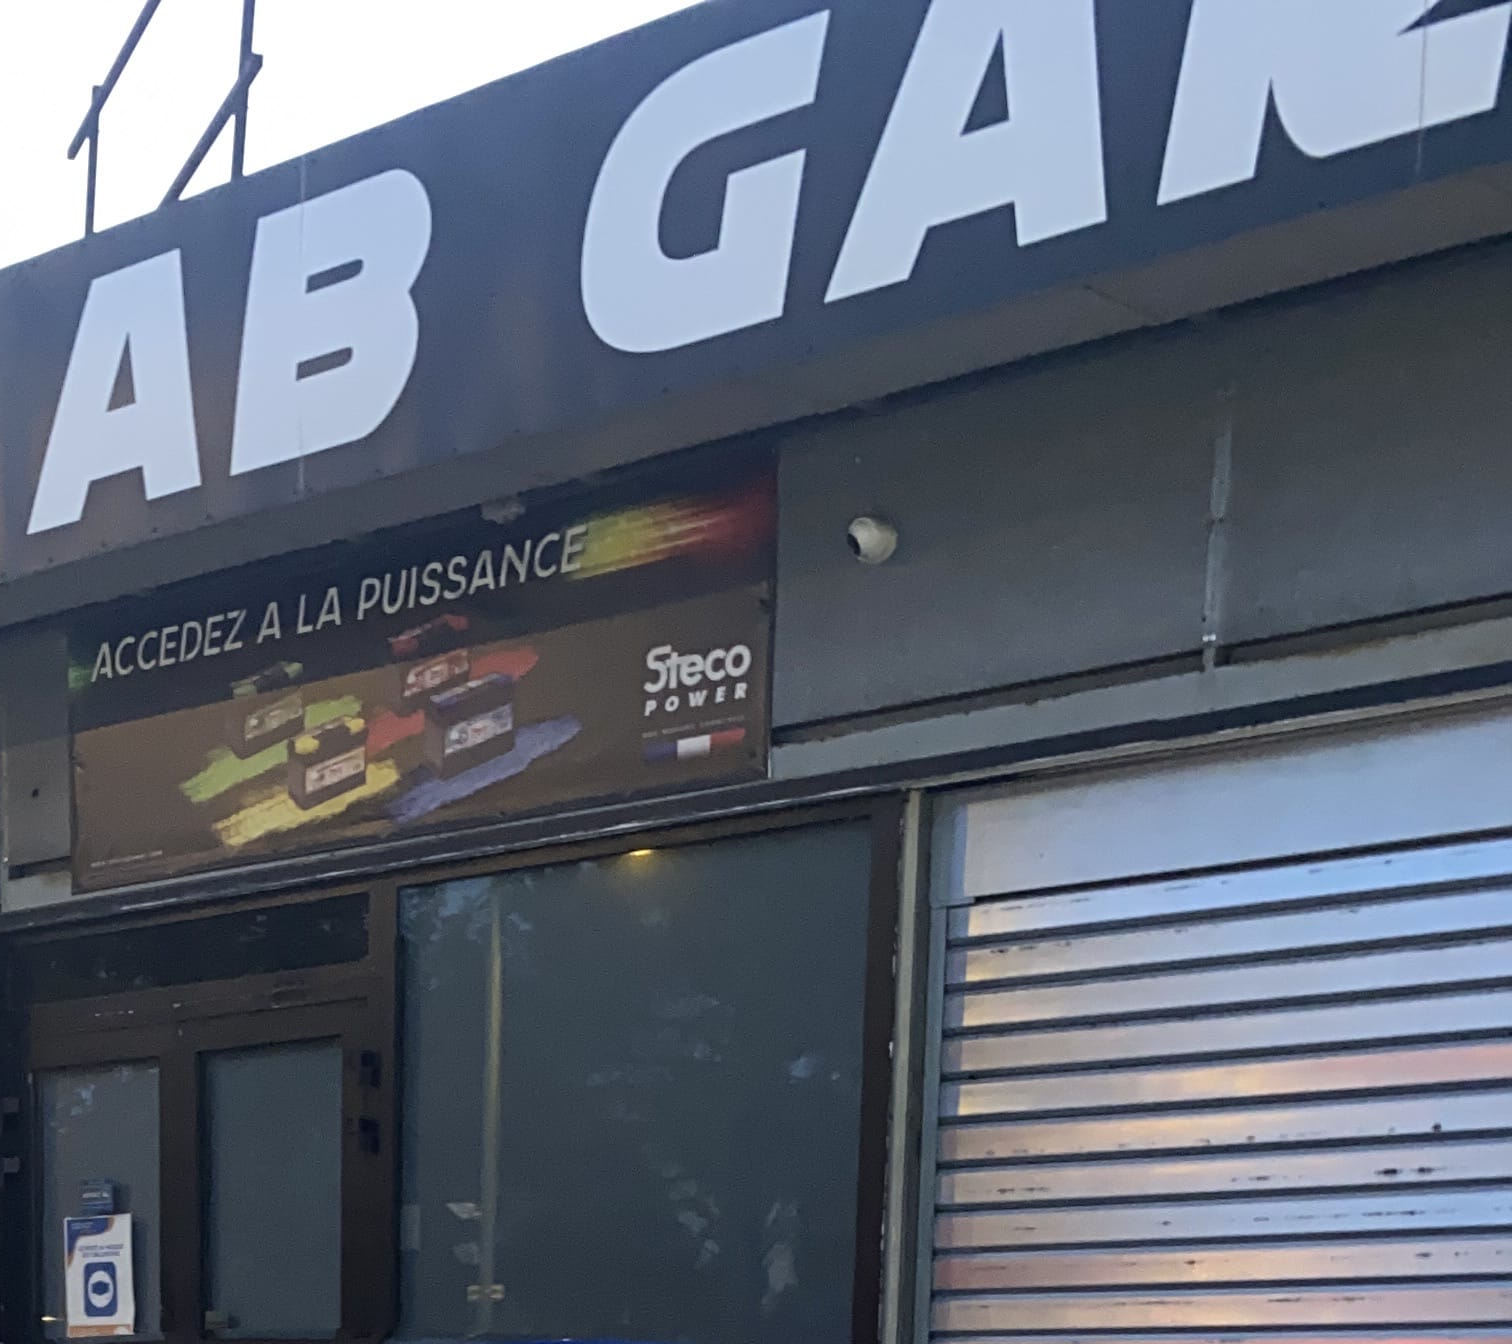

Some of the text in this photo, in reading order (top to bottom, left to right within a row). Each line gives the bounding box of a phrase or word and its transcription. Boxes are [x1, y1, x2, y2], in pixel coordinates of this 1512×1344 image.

[24, 168, 433, 534] AB
[91, 523, 588, 684] ACCEDEZ A LA PUISSANCE
[643, 644, 751, 693] Steco
[644, 682, 748, 716] POWER
